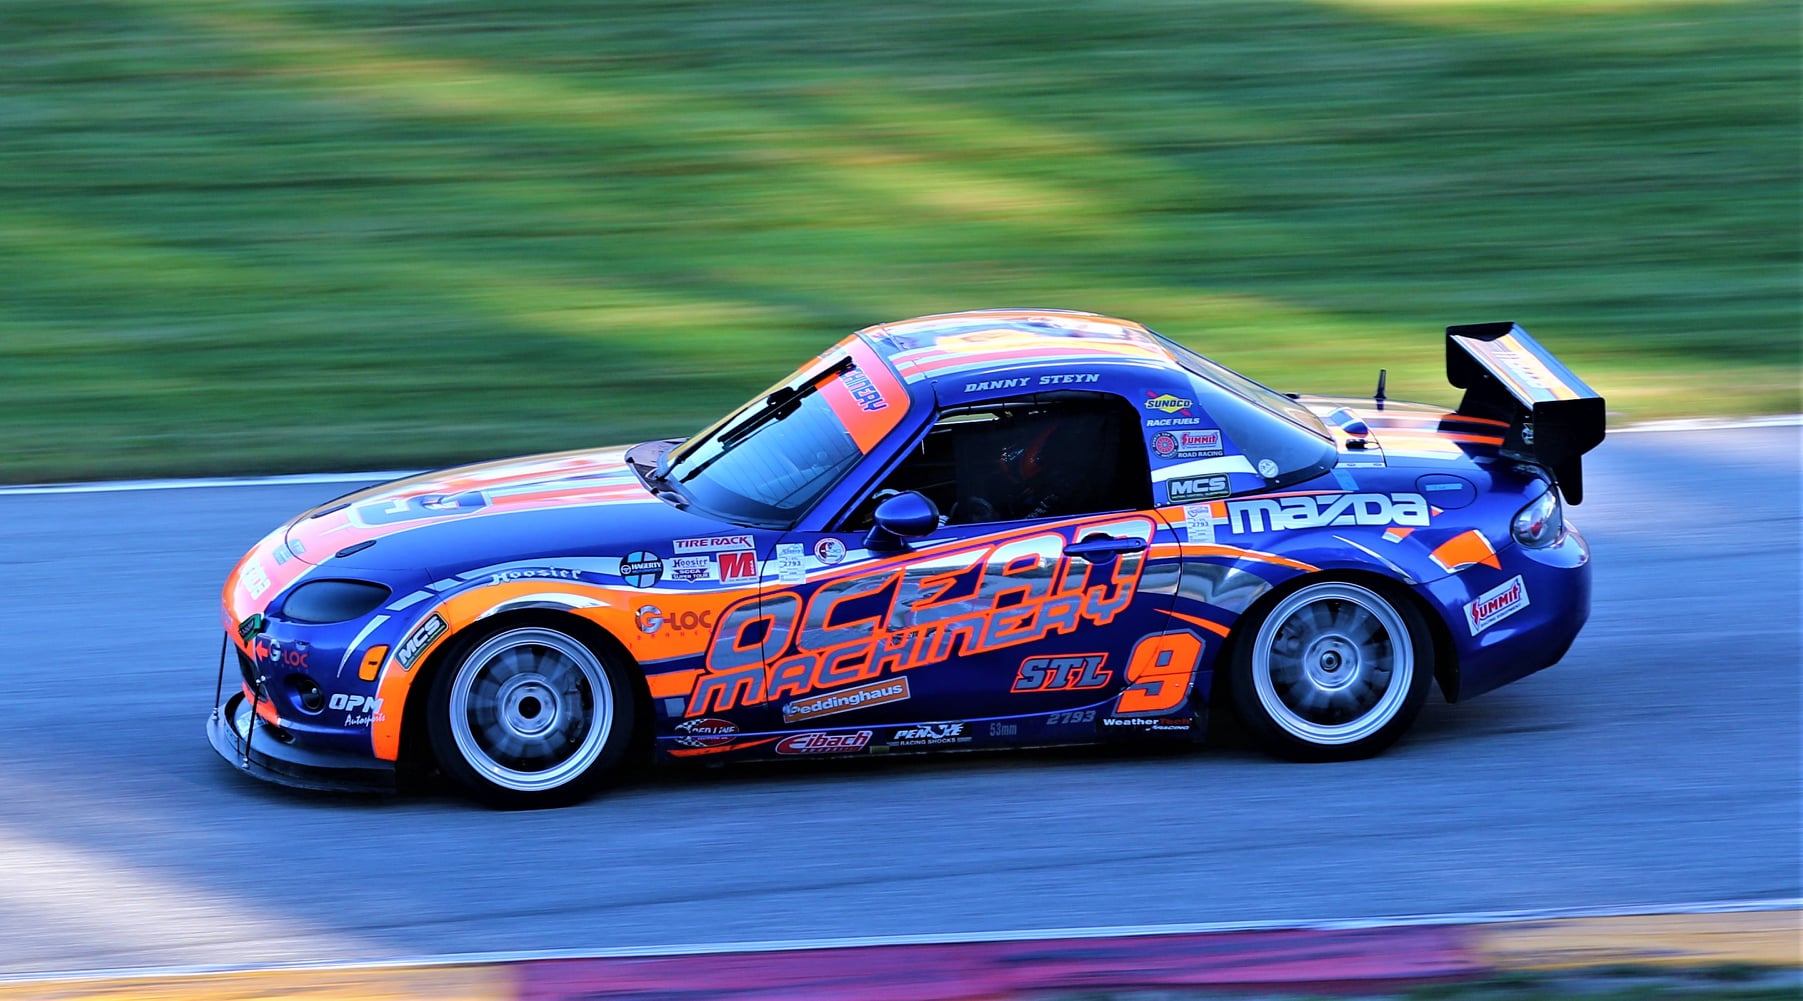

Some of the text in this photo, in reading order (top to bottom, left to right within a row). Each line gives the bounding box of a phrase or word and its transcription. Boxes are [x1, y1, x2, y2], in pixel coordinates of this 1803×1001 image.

[839, 367, 887, 411] CHINERY
[964, 373, 1100, 393] DANNY STEYN
[1147, 399, 1191, 408] SUNOCO
[1146, 418, 1200, 427] RACE FUELS
[1171, 477, 1226, 495] MCS
[1227, 493, 1430, 534] mazda
[676, 536, 752, 548] TIRE RACK
[673, 558, 708, 568] Hoosier
[487, 567, 582, 586] Hoosier
[704, 514, 1157, 675] OCEAN
[1471, 585, 1519, 625] SUMMIT
[635, 605, 712, 634] G-LOC
[398, 615, 441, 665] MCS
[684, 580, 1135, 717] MACHINERY
[1010, 653, 1113, 693] STL
[1112, 629, 1206, 717] 9
[1046, 710, 1097, 725] 2793
[990, 723, 1017, 737] 53mm
[775, 731, 873, 754] Eibach
